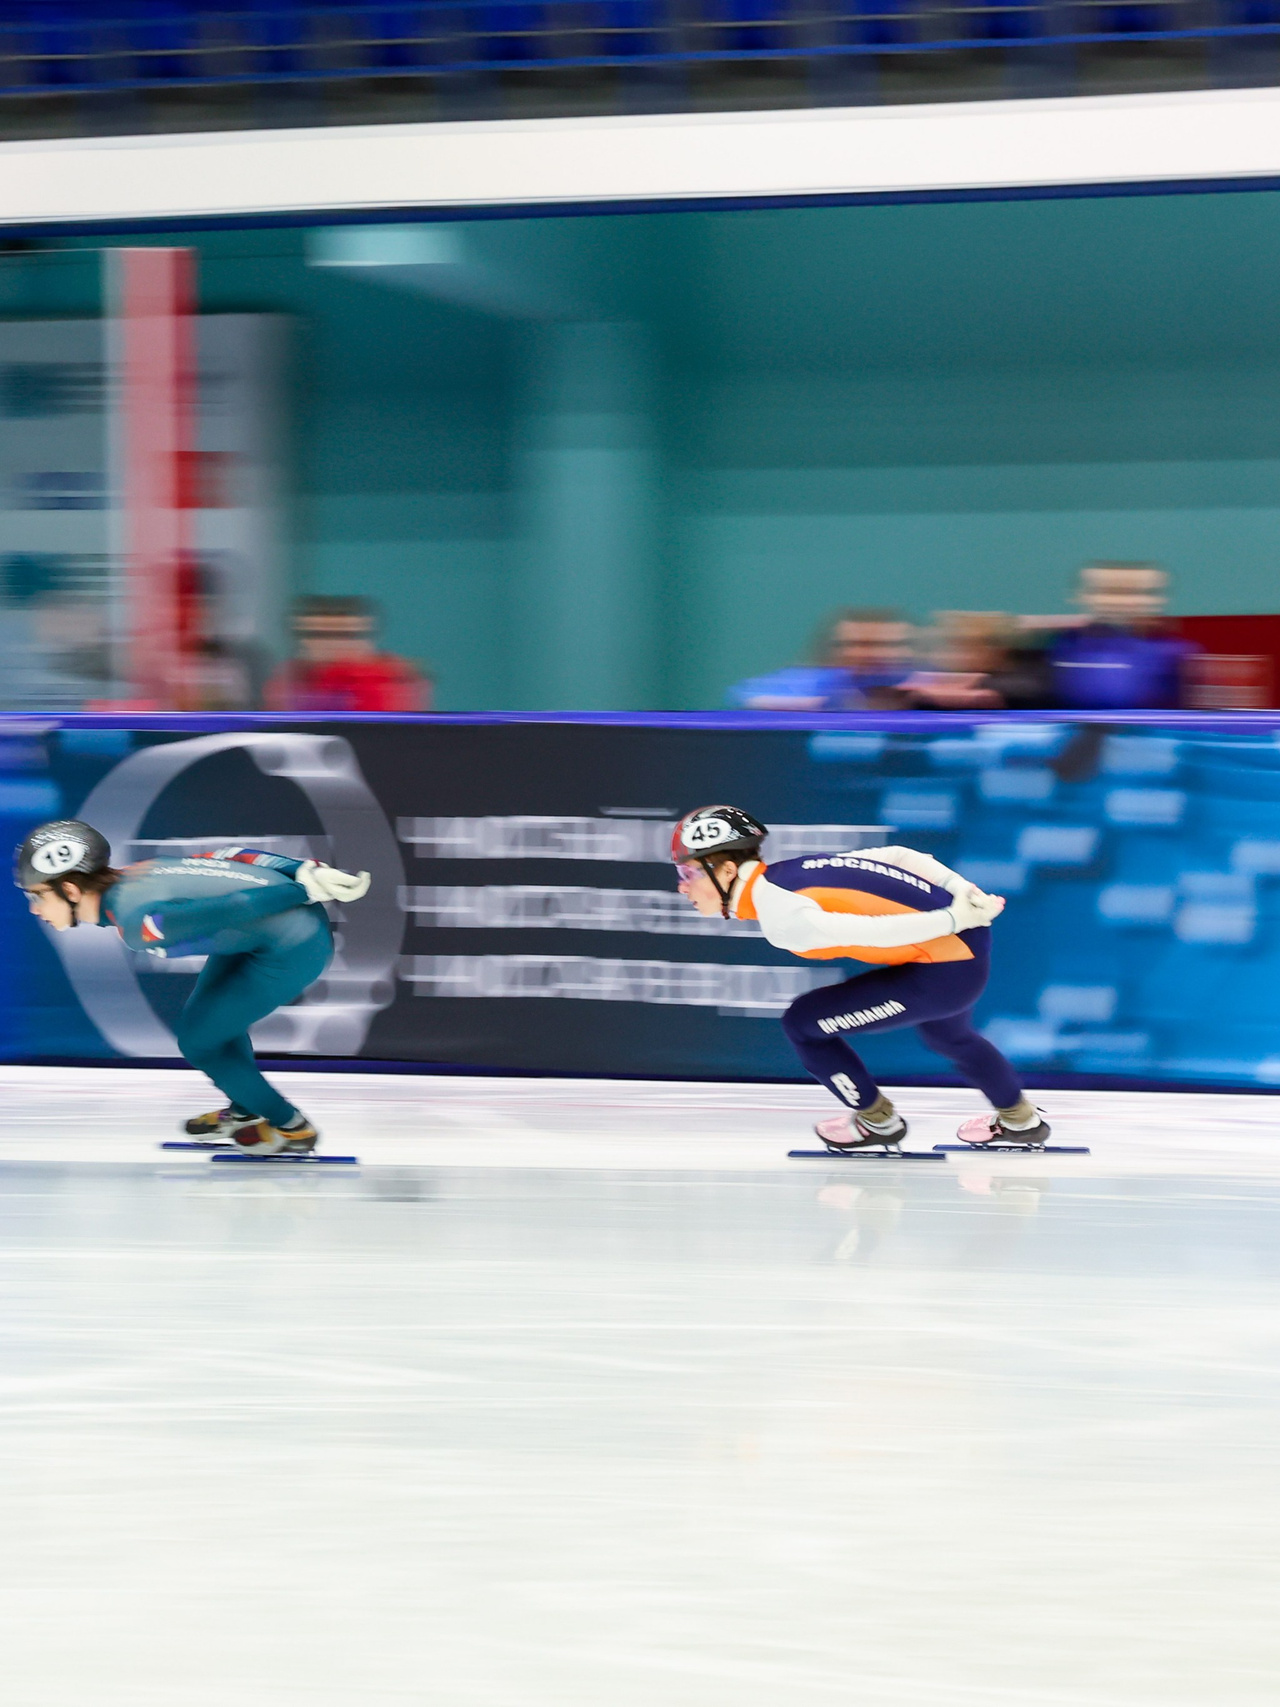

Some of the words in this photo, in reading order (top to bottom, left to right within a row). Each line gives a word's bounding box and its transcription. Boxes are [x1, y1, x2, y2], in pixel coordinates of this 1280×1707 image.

[692, 821, 720, 841] 45
[43, 845, 72, 867] 19
[801, 857, 931, 894] ЯРОСЛАВИЯ
